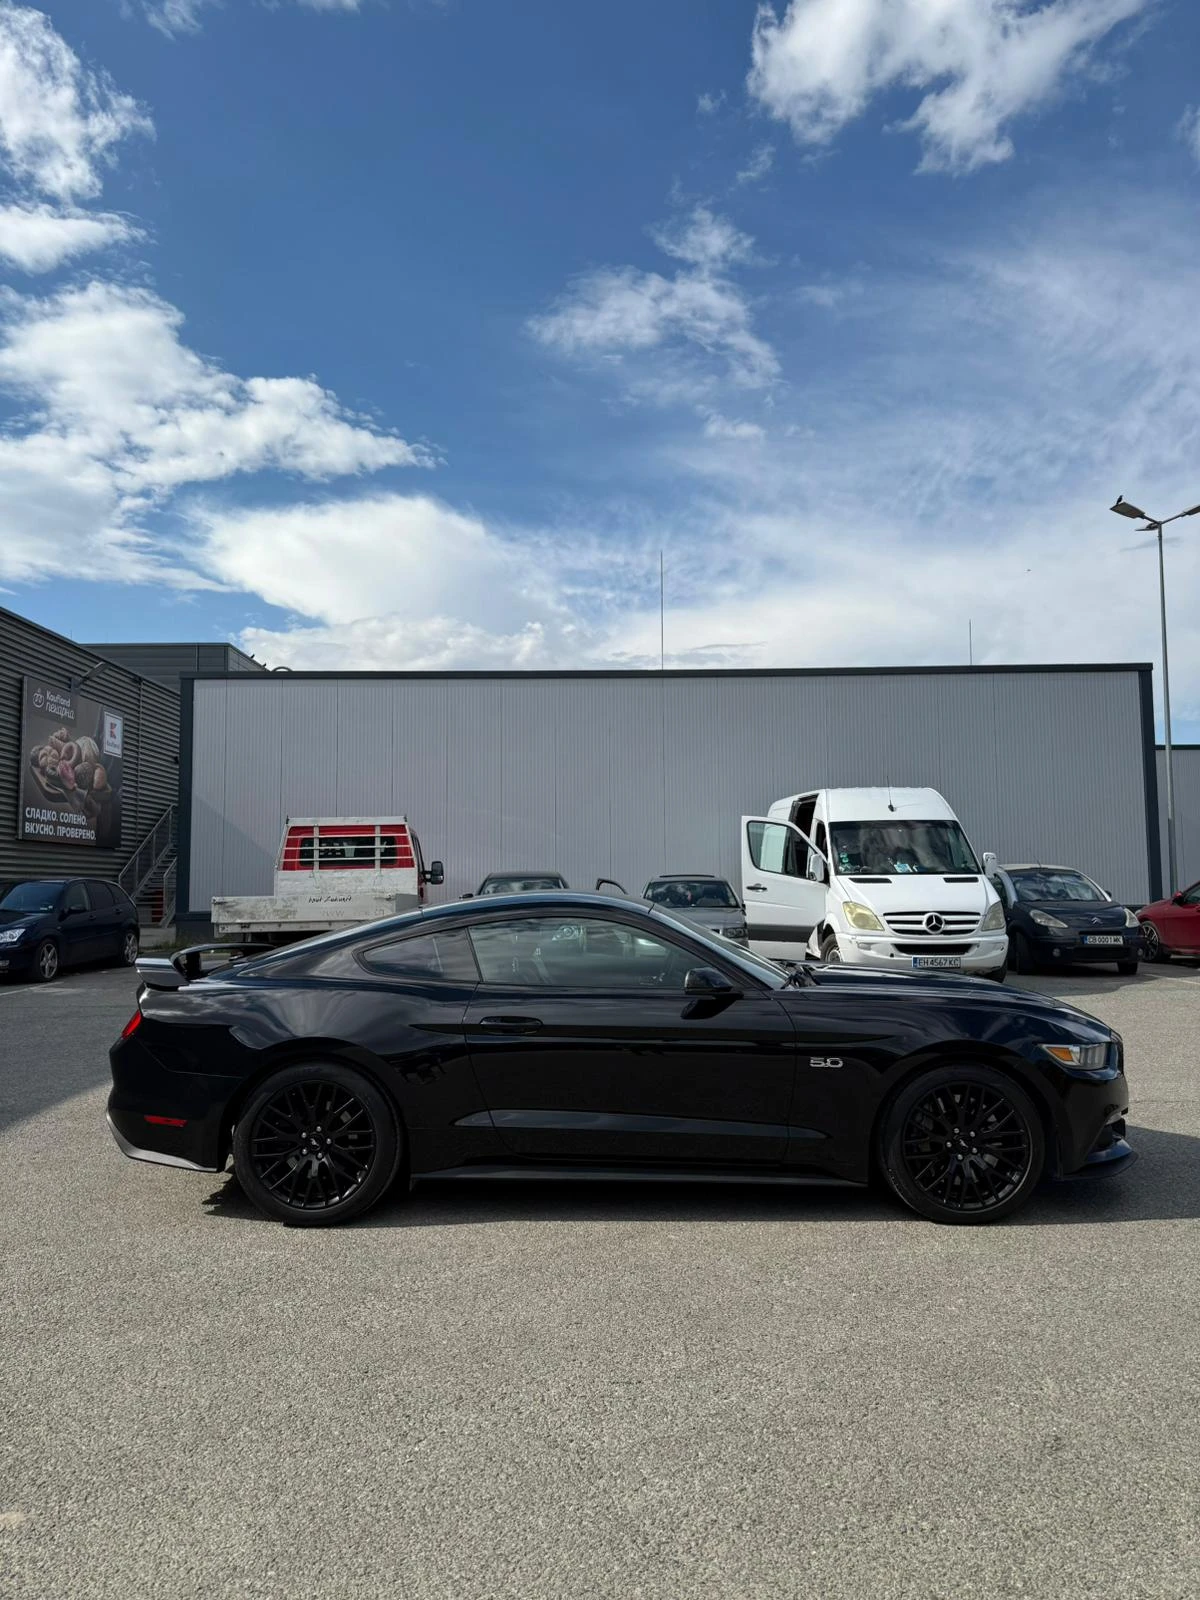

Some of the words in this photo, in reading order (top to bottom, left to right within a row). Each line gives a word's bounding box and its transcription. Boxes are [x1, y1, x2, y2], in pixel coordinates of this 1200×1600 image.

[25, 806, 59, 822] СЛАДКО.
[60, 812, 88, 826] СОЛЕНО.
[24, 822, 56, 836] ВКУСНО.
[56, 825, 97, 841] ПРОВЕРЕНО.
